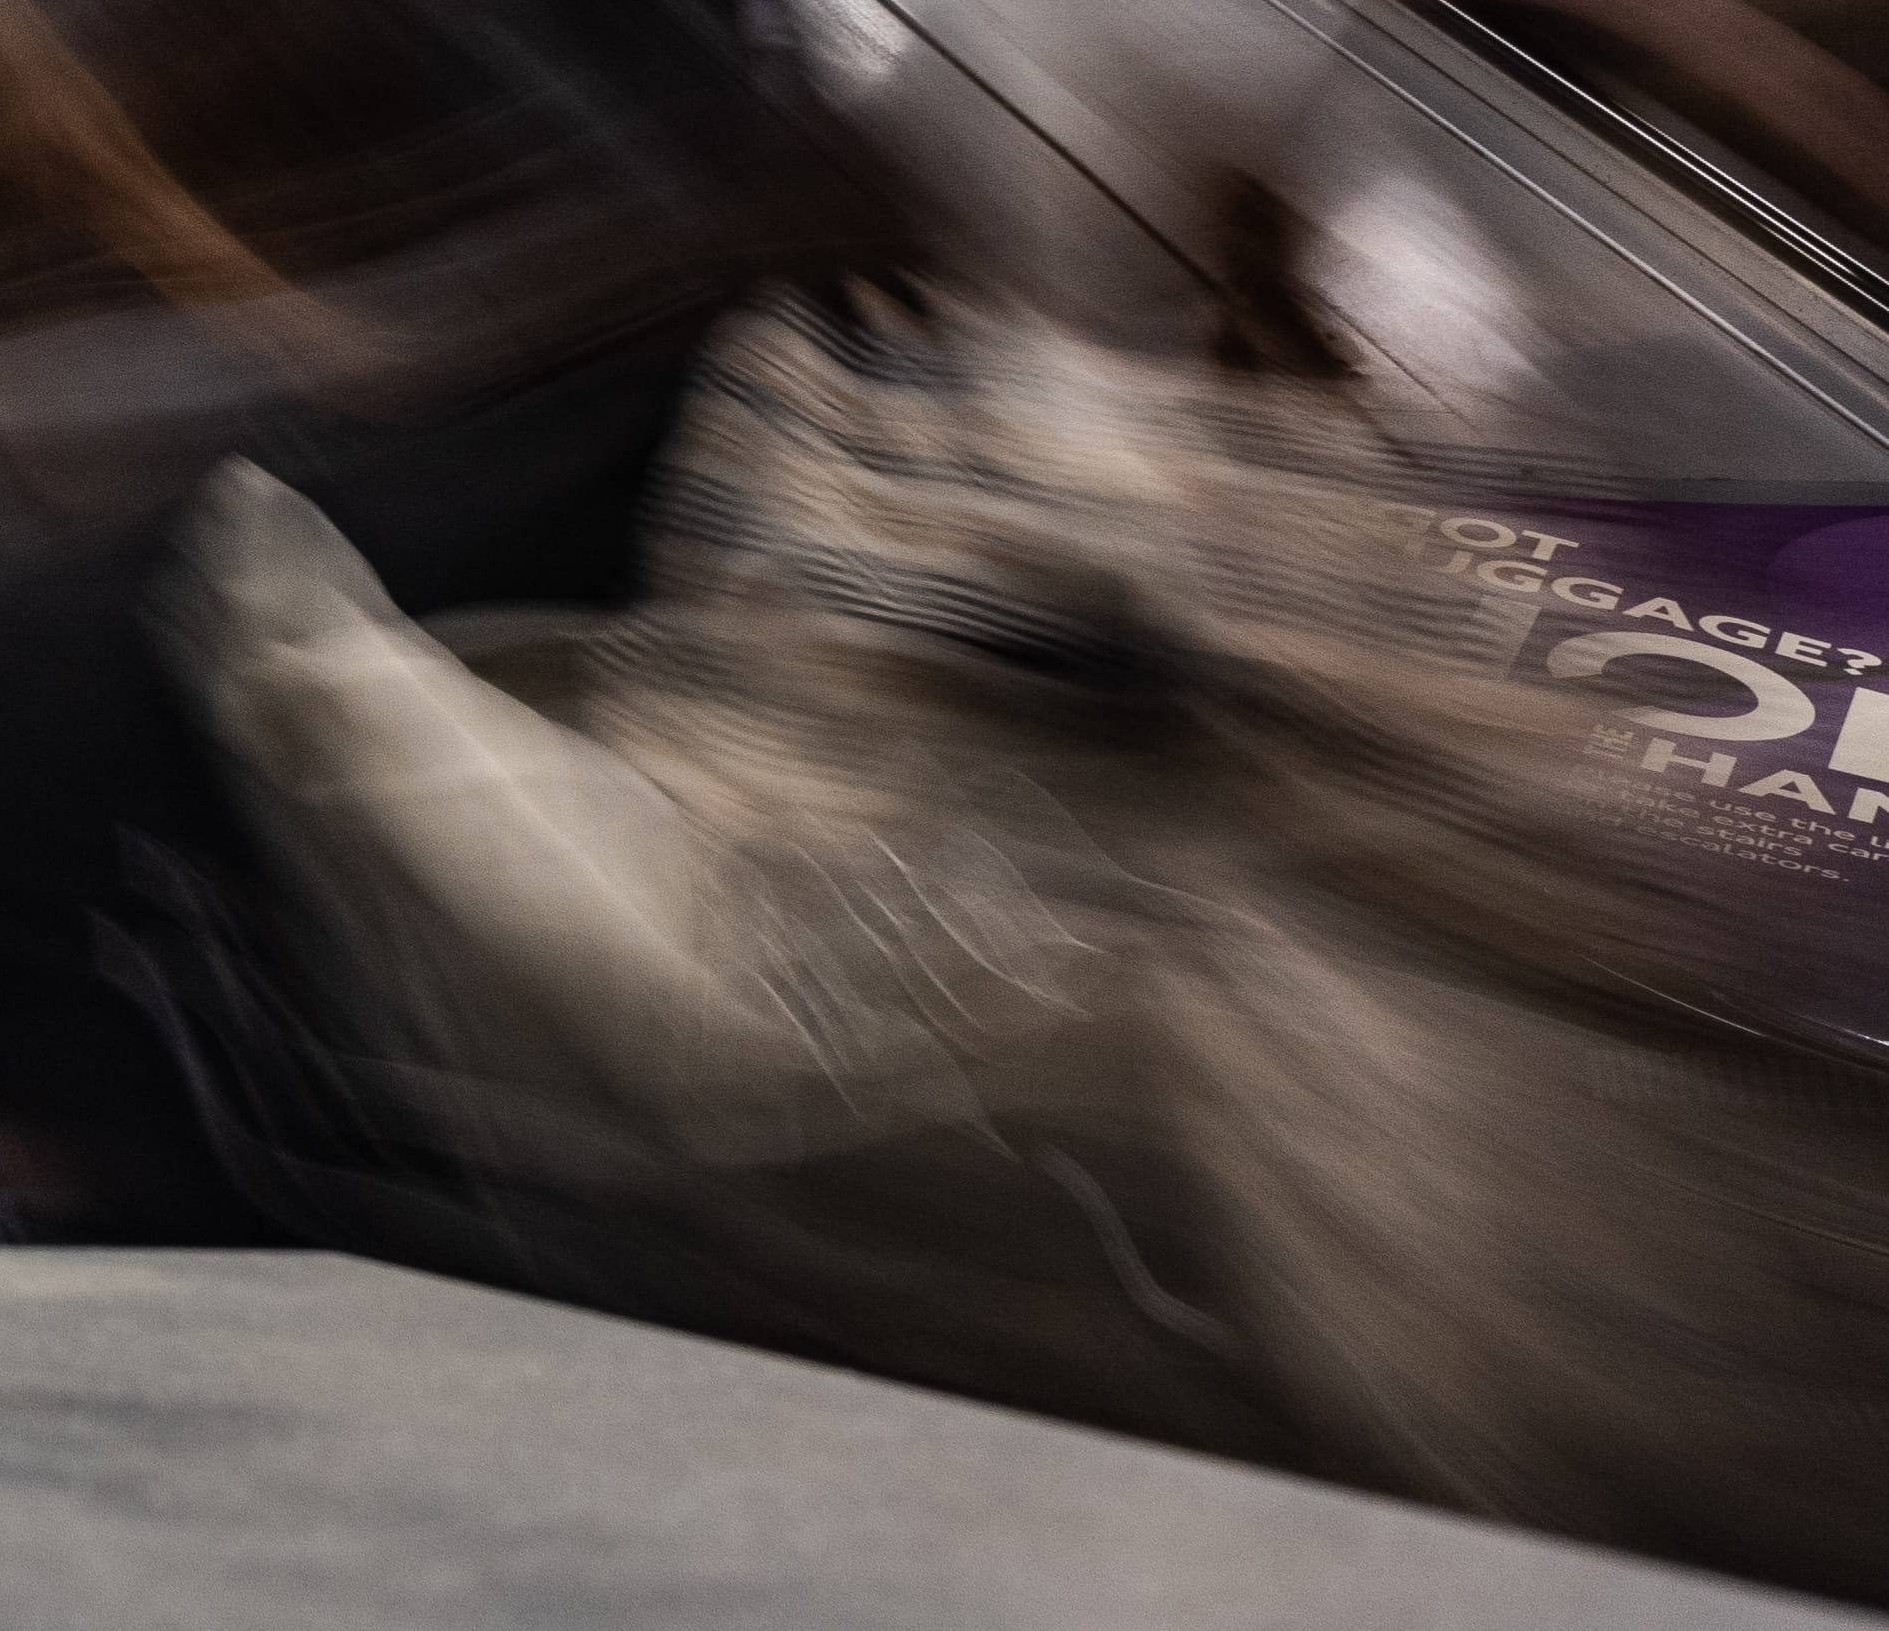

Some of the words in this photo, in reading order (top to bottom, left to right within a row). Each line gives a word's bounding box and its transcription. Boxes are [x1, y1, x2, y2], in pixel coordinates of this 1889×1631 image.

[1695, 824, 1803, 858] stairs
[1709, 799, 1777, 821] use
[1789, 816, 1857, 843] the
[1711, 813, 1814, 846] extra
[1827, 840, 1889, 863] car
[1636, 824, 1851, 883] escalators.
